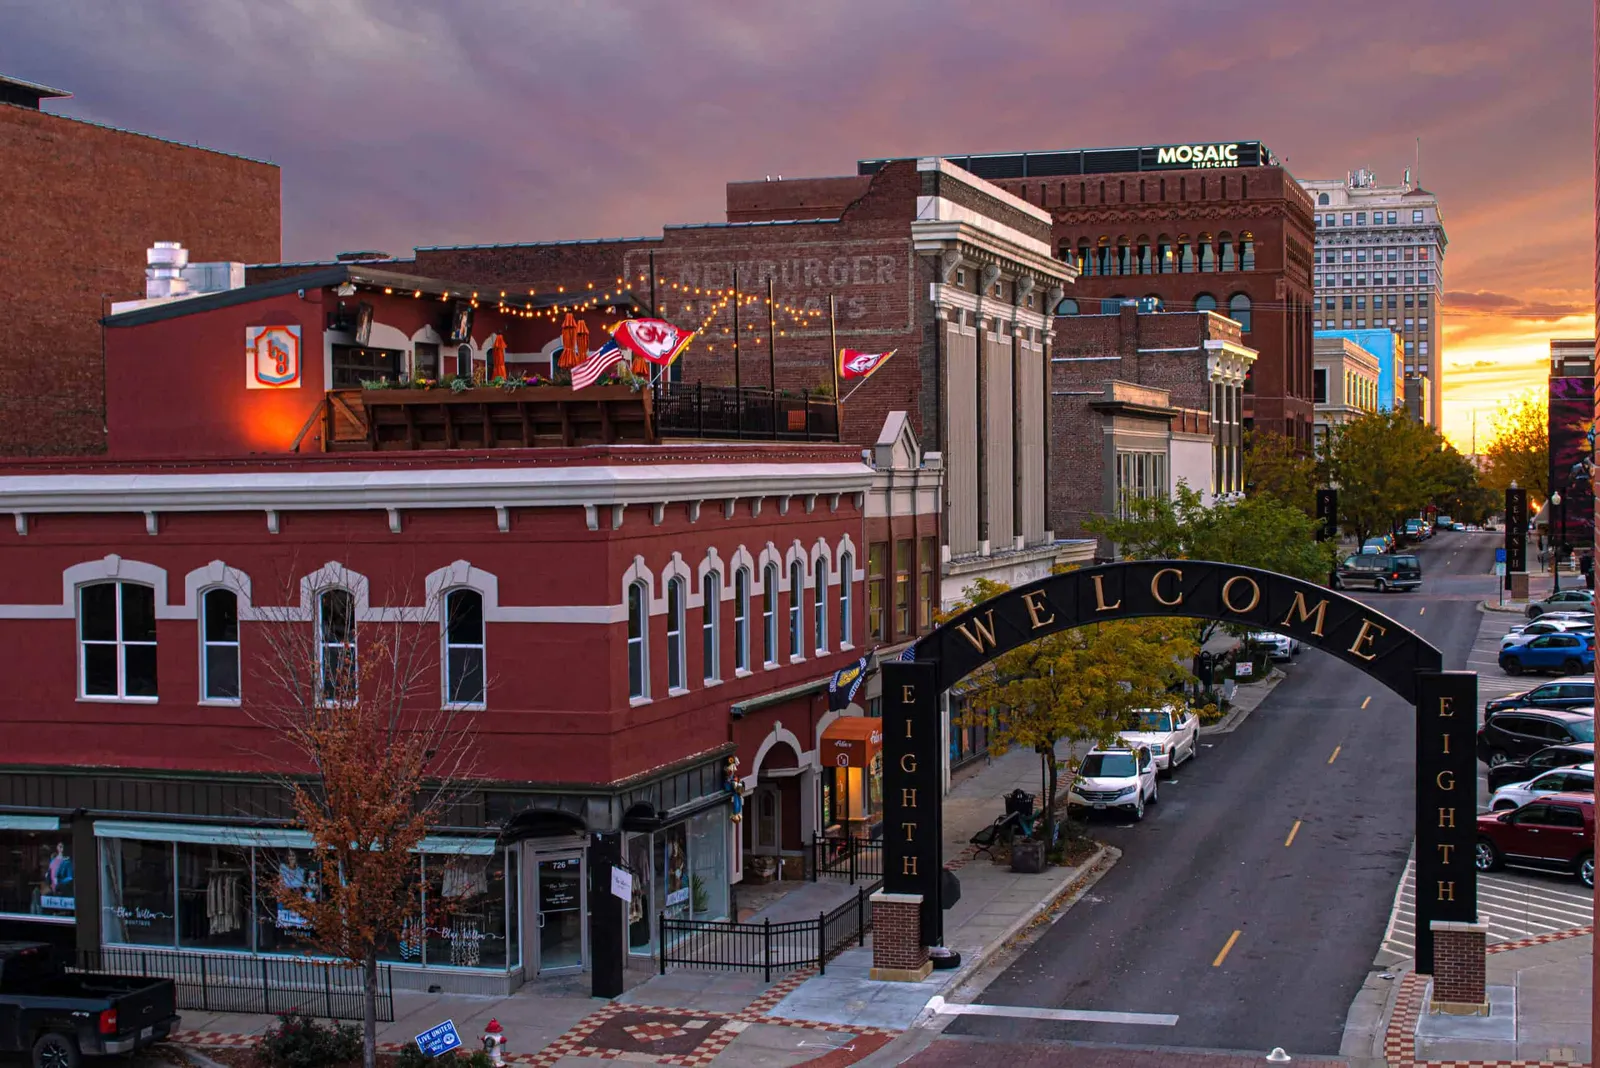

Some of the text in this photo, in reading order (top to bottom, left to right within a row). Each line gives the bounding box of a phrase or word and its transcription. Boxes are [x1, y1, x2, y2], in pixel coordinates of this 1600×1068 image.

[1157, 144, 1238, 163] MOSAIC
[680, 255, 896, 286] NEWBURGER
[955, 568, 1387, 661] WELCOME
[900, 685, 918, 875] EIGHTH
[1436, 697, 1456, 901] EIGHTH
[417, 1023, 452, 1044] LIVE UNITED
